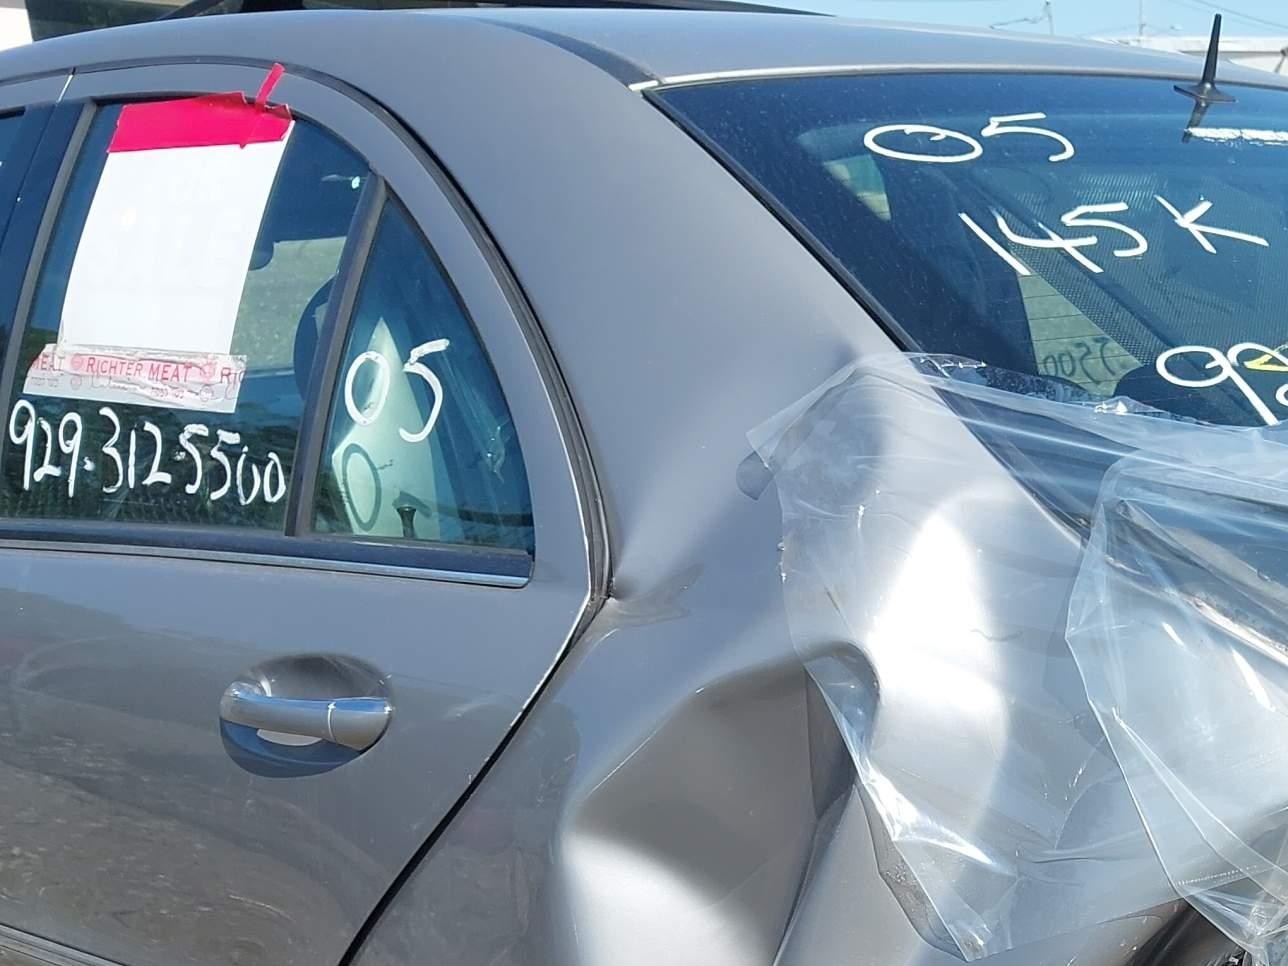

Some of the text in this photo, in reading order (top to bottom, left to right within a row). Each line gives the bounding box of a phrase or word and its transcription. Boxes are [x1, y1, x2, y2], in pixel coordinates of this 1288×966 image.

[863, 111, 1075, 163] 05
[957, 194, 1270, 276] 145 K
[149, 362, 194, 383] MEAT
[344, 338, 450, 443] 05
